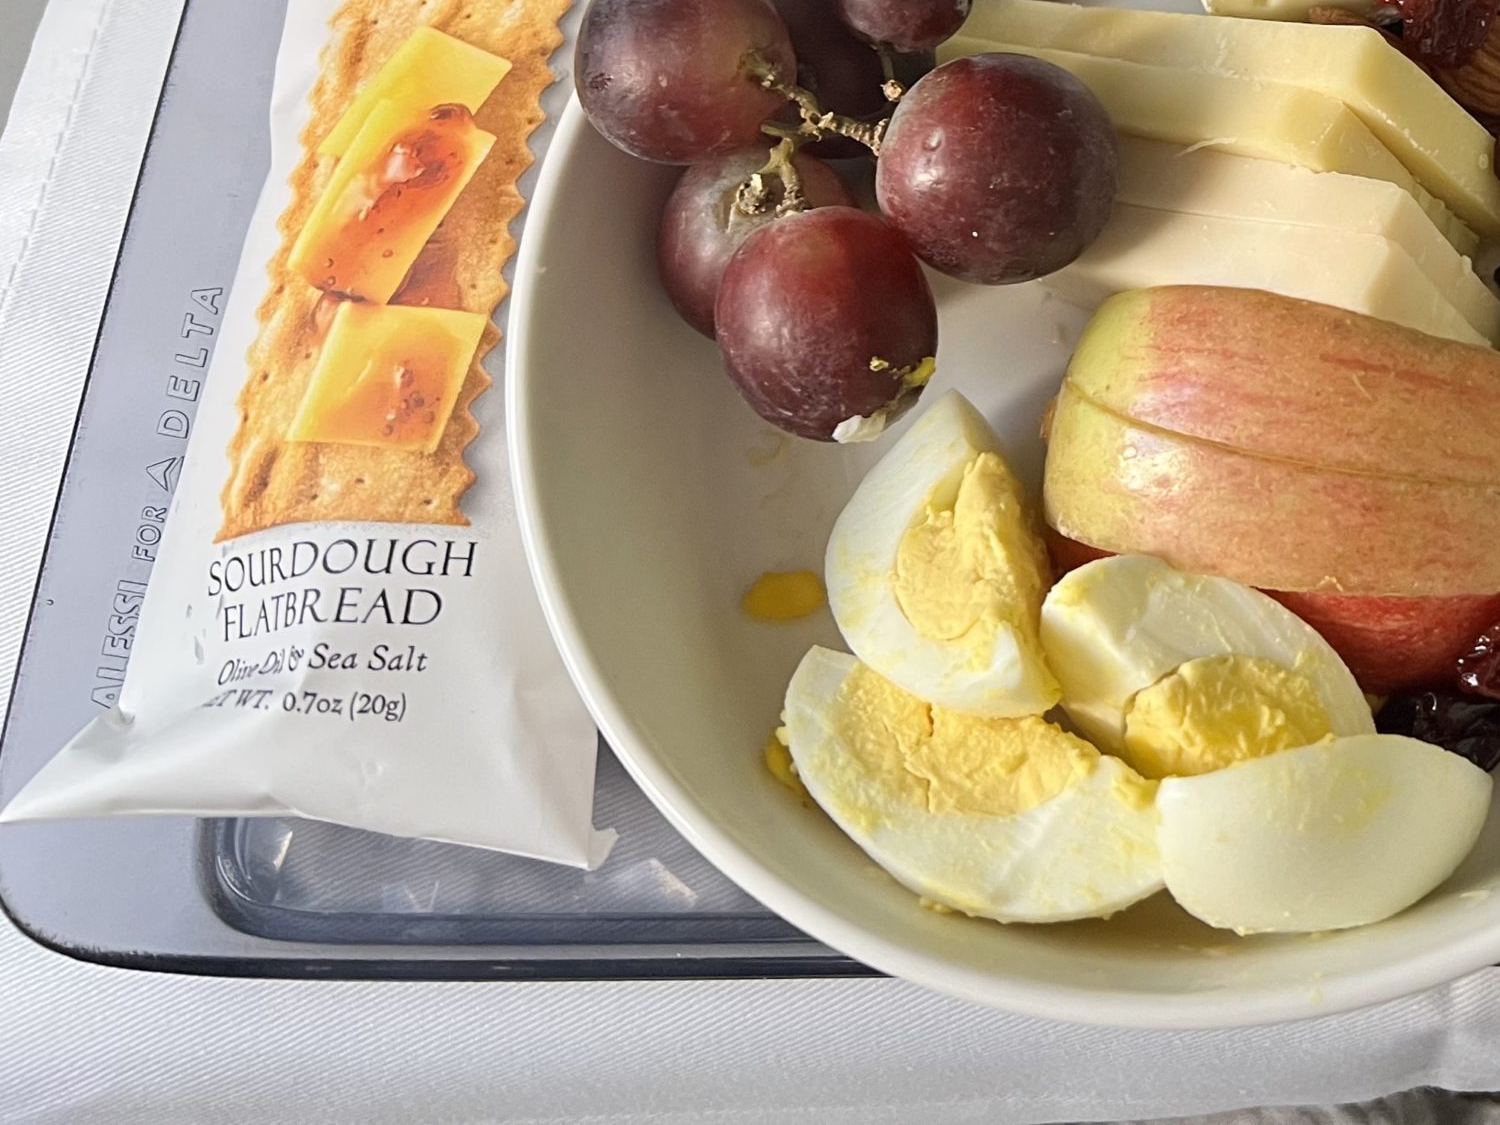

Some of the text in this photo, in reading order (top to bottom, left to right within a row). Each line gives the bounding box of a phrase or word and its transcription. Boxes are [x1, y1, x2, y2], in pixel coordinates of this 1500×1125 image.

[157, 286, 225, 441] DELTA
[131, 505, 168, 563] FOR
[207, 538, 479, 597] SOURDOUGH
[223, 586, 444, 642] FLATBREAD
[90, 579, 149, 709] ALESSI
[307, 643, 359, 670] Sea
[367, 644, 429, 672] Salt
[282, 691, 343, 715] 0.7oz
[349, 692, 407, 723] (20g)
